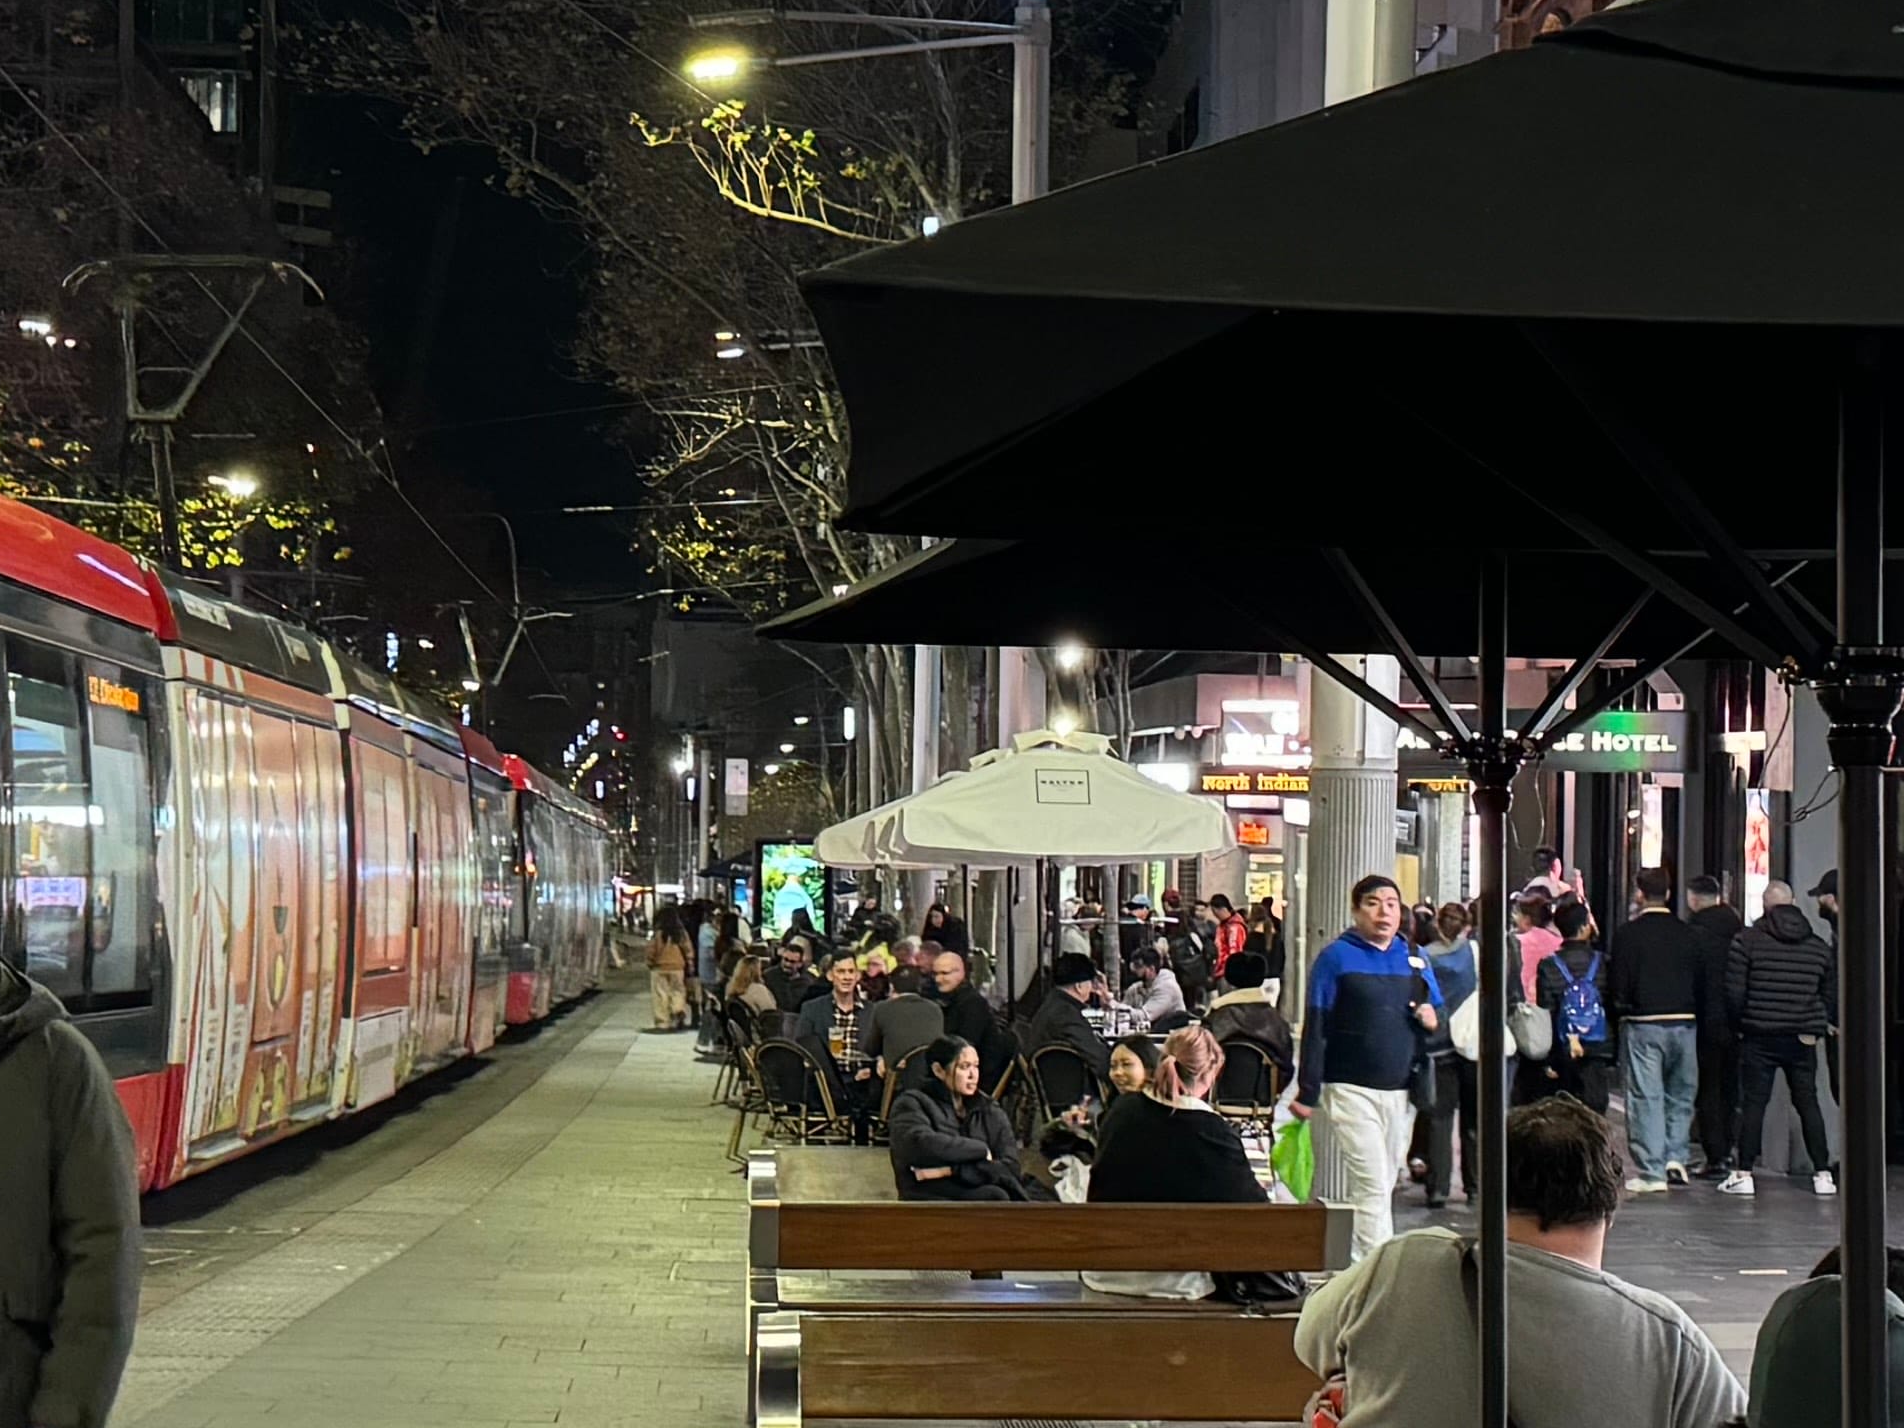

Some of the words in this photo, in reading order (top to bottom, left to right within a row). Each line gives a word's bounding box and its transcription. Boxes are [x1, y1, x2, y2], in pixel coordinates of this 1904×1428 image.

[1590, 730, 1678, 752] HOTEL
[1202, 774, 1250, 791] North
[1258, 774, 1309, 791] Indian
